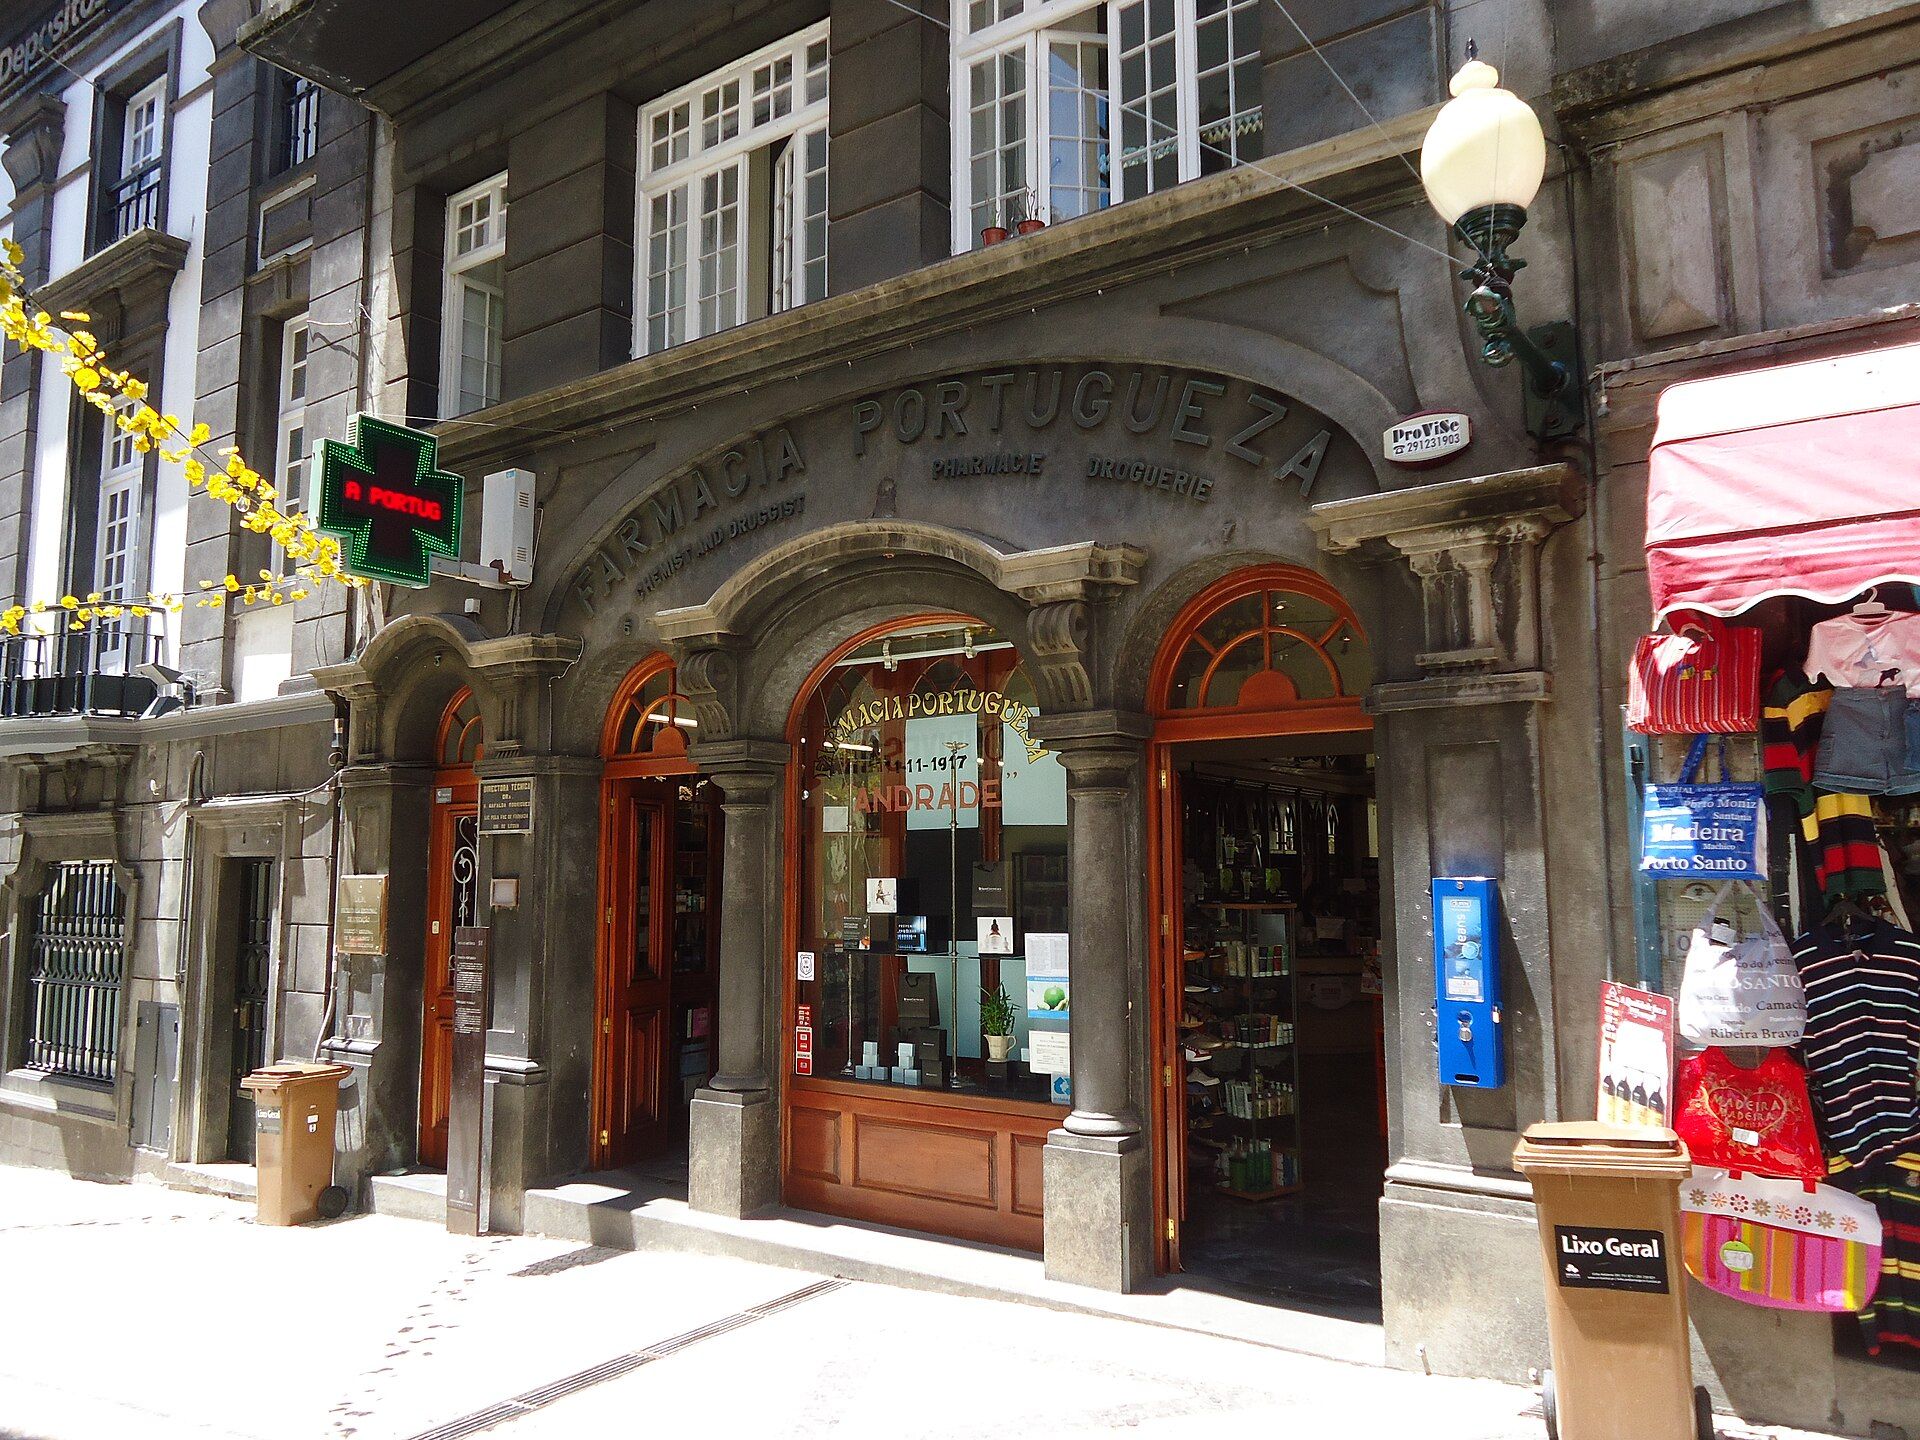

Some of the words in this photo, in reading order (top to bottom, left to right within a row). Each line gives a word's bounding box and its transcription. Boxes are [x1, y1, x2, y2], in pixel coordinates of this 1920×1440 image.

[852, 370, 1332, 498] PORTUGUEZA
[1392, 419, 1460, 443] ProViSe
[1407, 433, 1460, 453] 291231903
[931, 453, 1045, 480] PHARMACIE
[1087, 457, 1215, 501] DROGUERIE
[344, 480, 361, 501] A
[369, 486, 441, 520] PORTUG
[577, 427, 806, 618] FARMACIA
[729, 492, 806, 538] DRUGGIST
[853, 779, 1001, 815] ANDRADE
[1717, 799, 1757, 809] Moniz
[1713, 811, 1752, 821] Santana
[1651, 822, 1745, 843] Madeira
[1692, 855, 1748, 871] Santo
[1710, 1028, 1758, 1039] Ribeira
[1761, 1029, 1799, 1038] Brava
[1713, 1094, 1781, 1111] MADEIRA
[1561, 1234, 1604, 1255] Lixo
[1605, 1237, 1660, 1258] Geral
